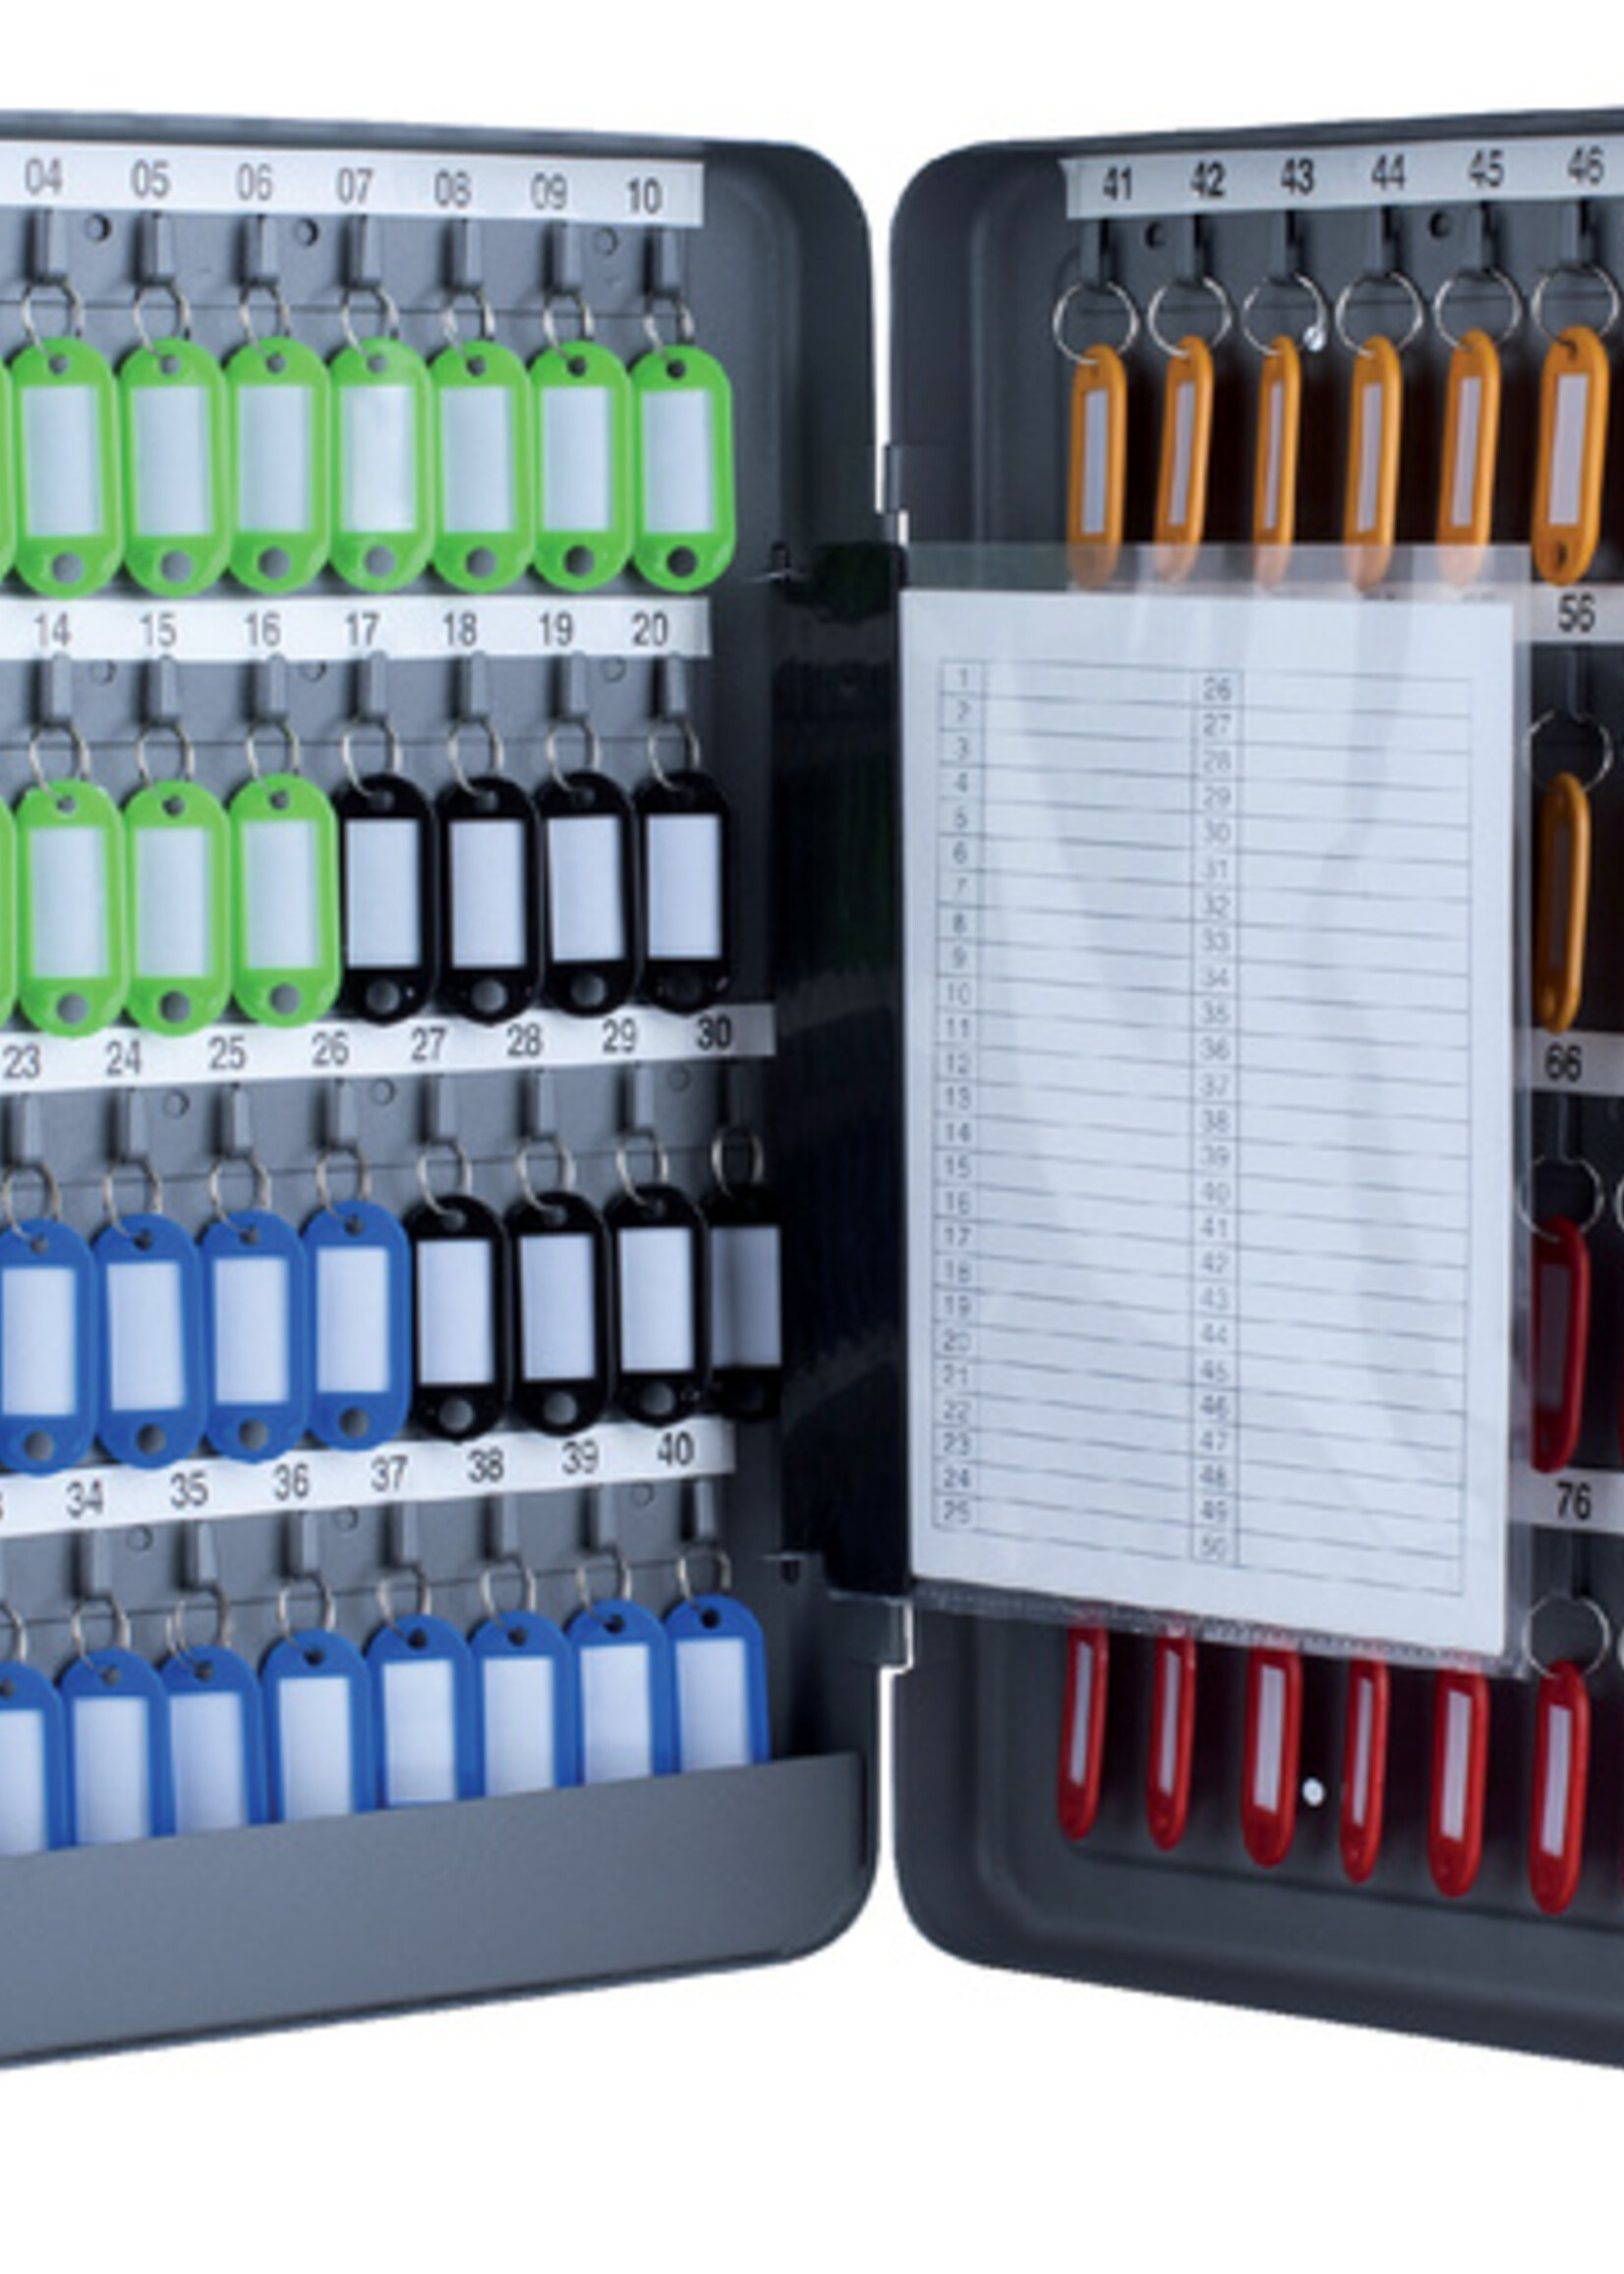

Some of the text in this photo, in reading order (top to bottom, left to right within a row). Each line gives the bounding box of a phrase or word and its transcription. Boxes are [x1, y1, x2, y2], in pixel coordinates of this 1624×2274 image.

[24, 157, 664, 216] 04 05 06 07 08 09 10
[1102, 146, 1604, 201] 41 42 43 44 45 46
[33, 611, 669, 650] 14 15 16 17 18 19 20
[1558, 595, 1596, 633] 56
[2, 1016, 733, 1080] 23 24 25 26 27 28 29 30
[1543, 1044, 1585, 1083] 66
[67, 1433, 695, 1520] 34 35 36 37 38 39 40
[1554, 1482, 1592, 1522] 76
